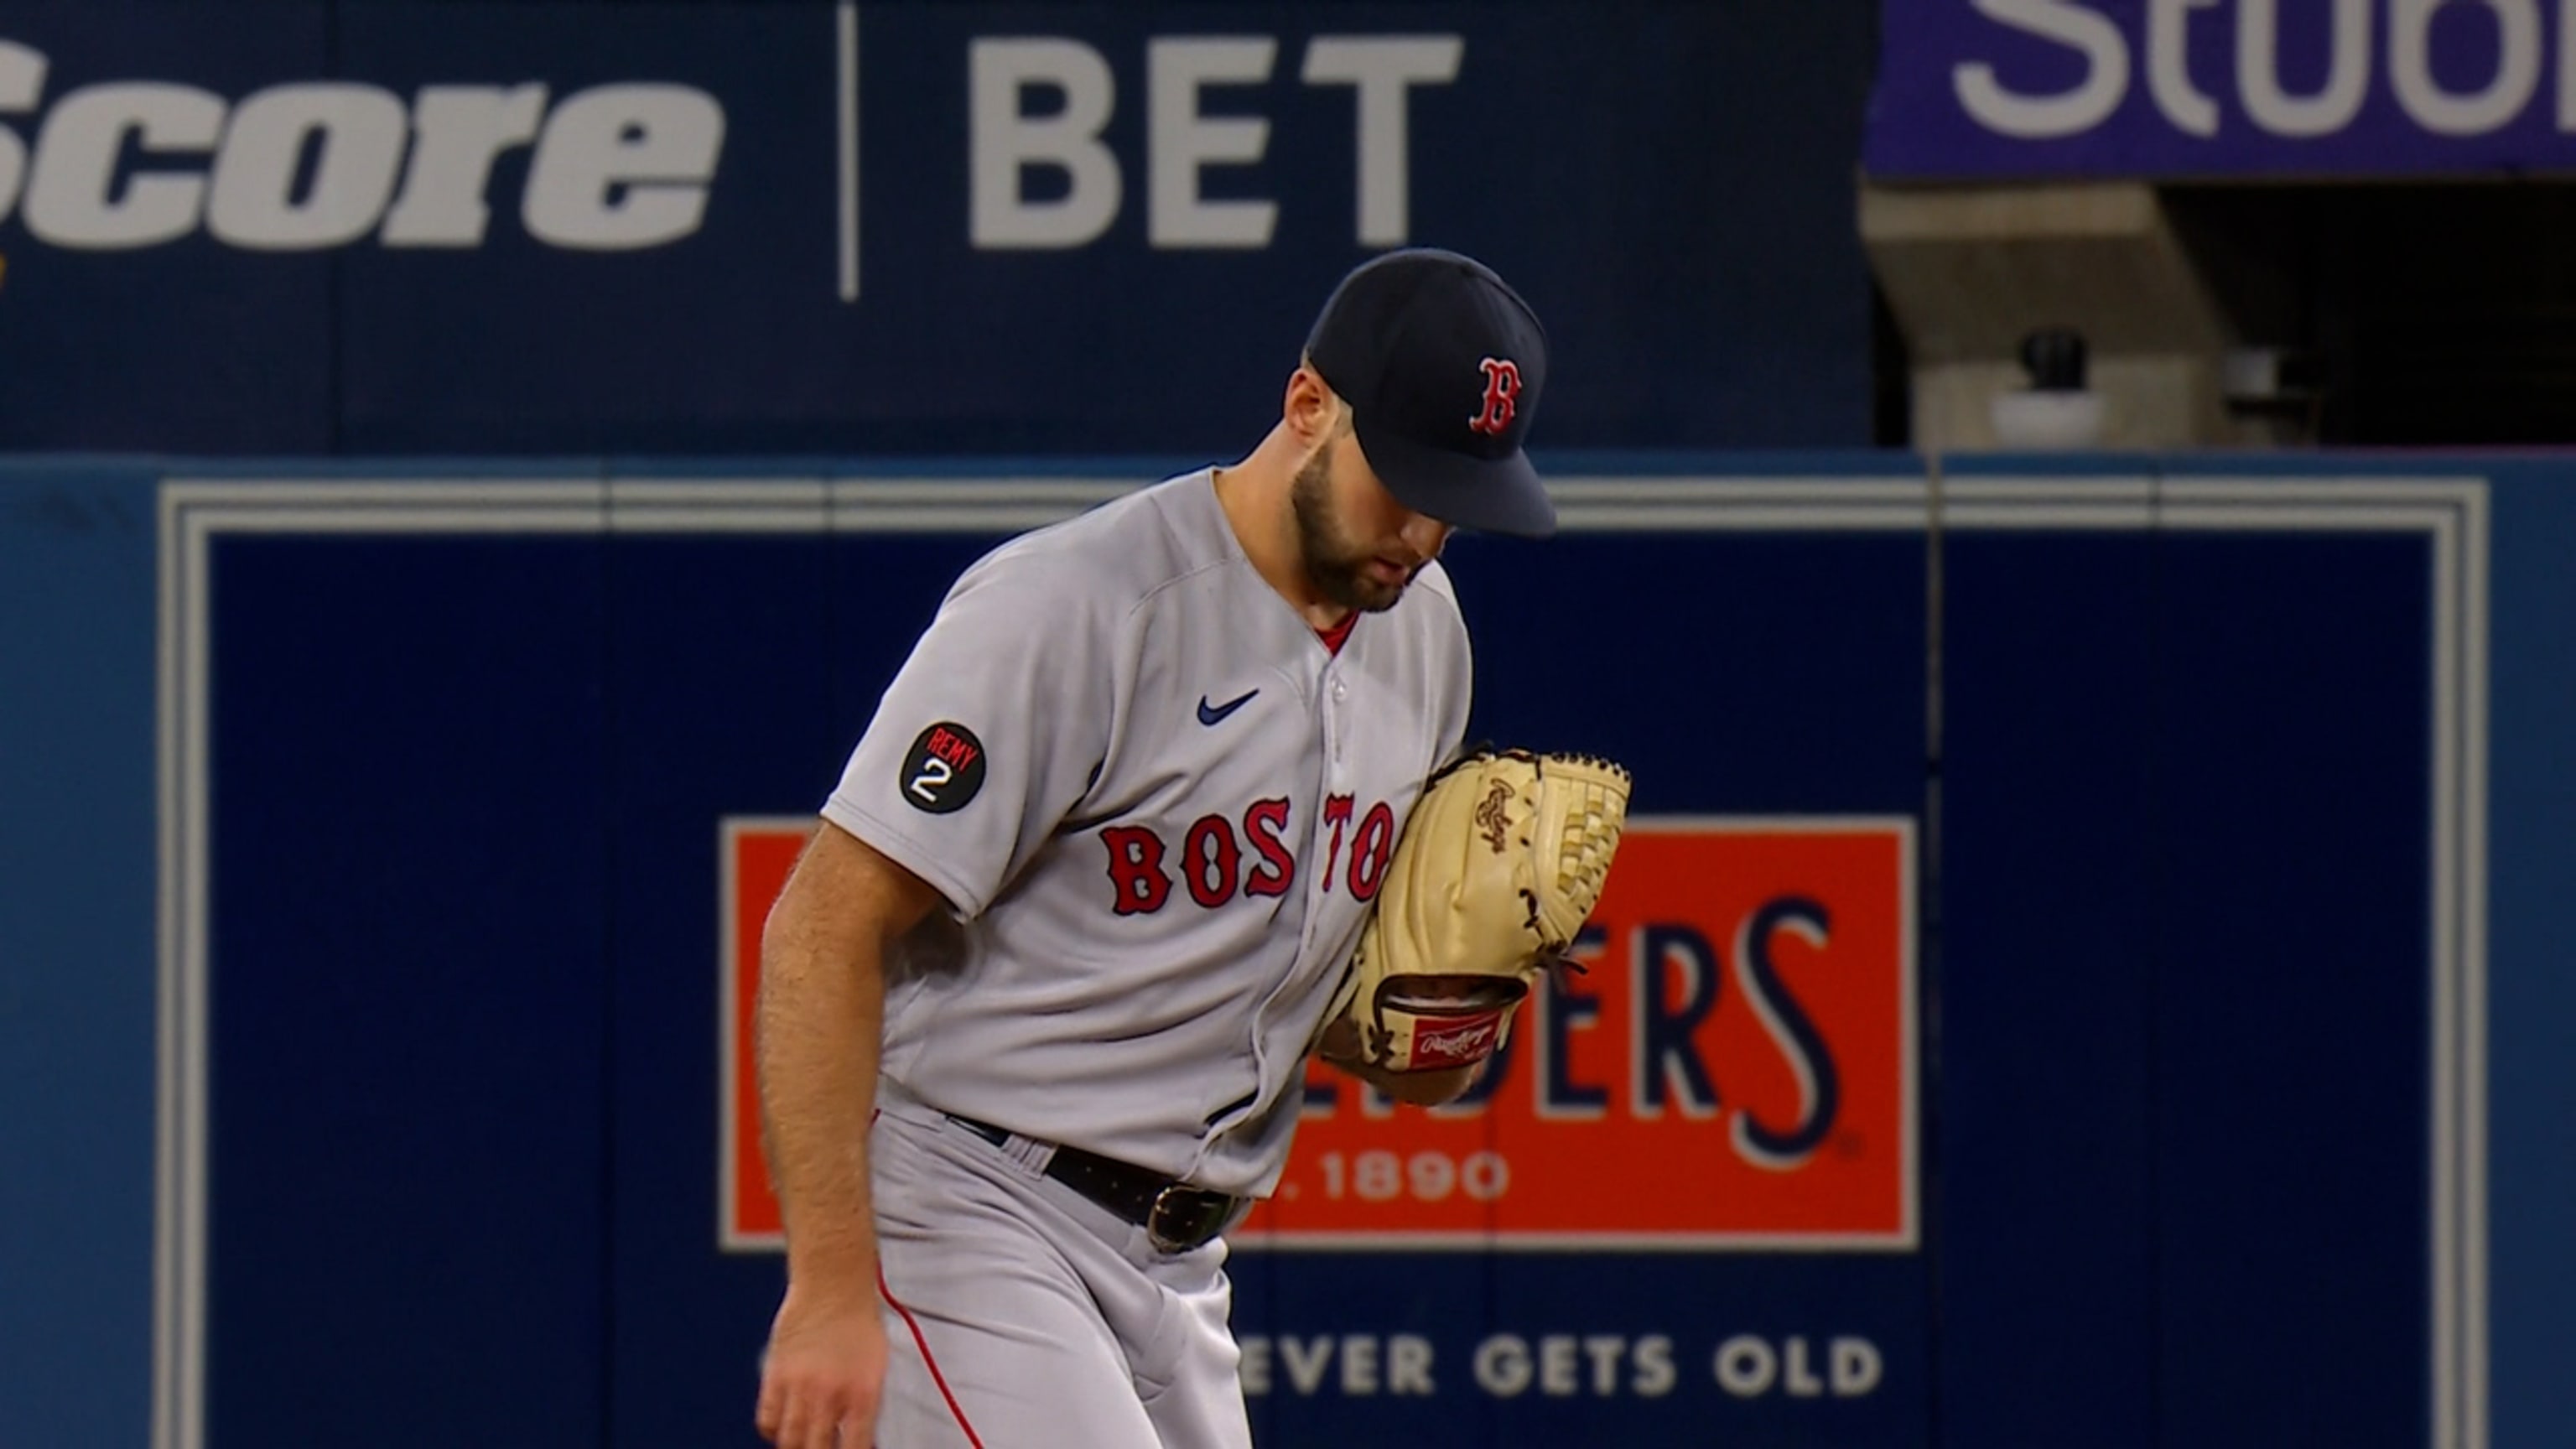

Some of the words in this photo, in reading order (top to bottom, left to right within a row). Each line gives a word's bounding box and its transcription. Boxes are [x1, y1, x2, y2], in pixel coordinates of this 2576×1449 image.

[1952, 0, 2576, 137] Stub
[969, 34, 1465, 250] BET
[1468, 356, 1522, 434] B
[910, 757, 953, 802] 2
[927, 727, 979, 772] REMY
[1317, 1148, 1511, 1202] 1890
[1472, 1334, 1678, 1396] GETS
[1713, 1334, 1883, 1396] OLD
